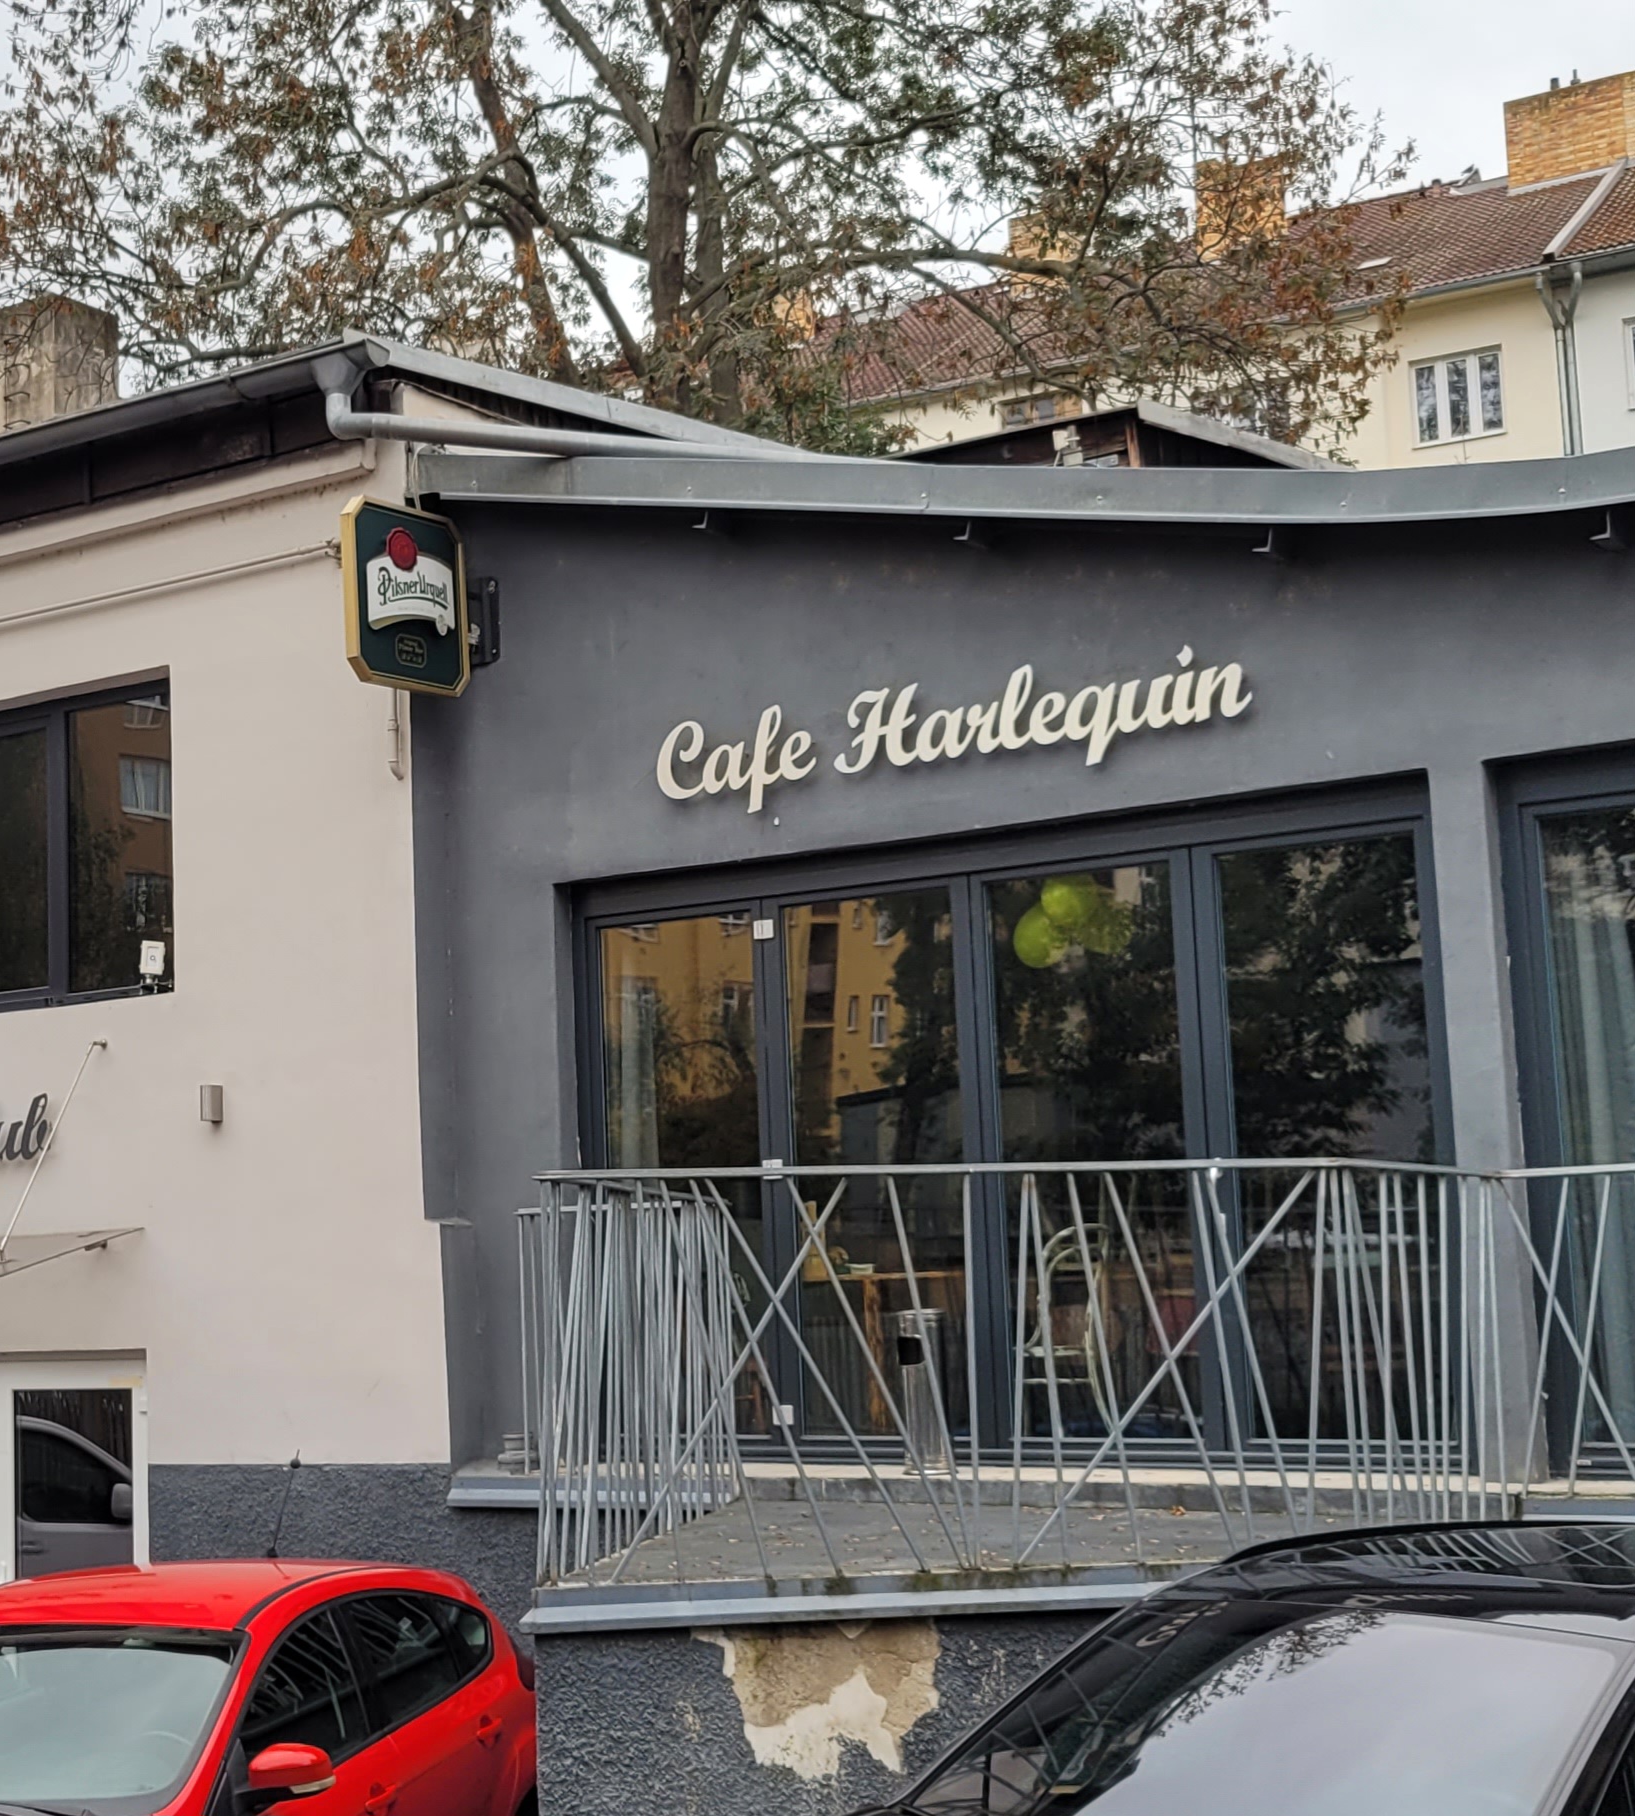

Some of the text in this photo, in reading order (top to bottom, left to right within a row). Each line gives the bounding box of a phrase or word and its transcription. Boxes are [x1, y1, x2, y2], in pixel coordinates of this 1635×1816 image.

[377, 566, 449, 608] Pilsner Urquell
[656, 645, 1252, 814] Cafe Harlequin
